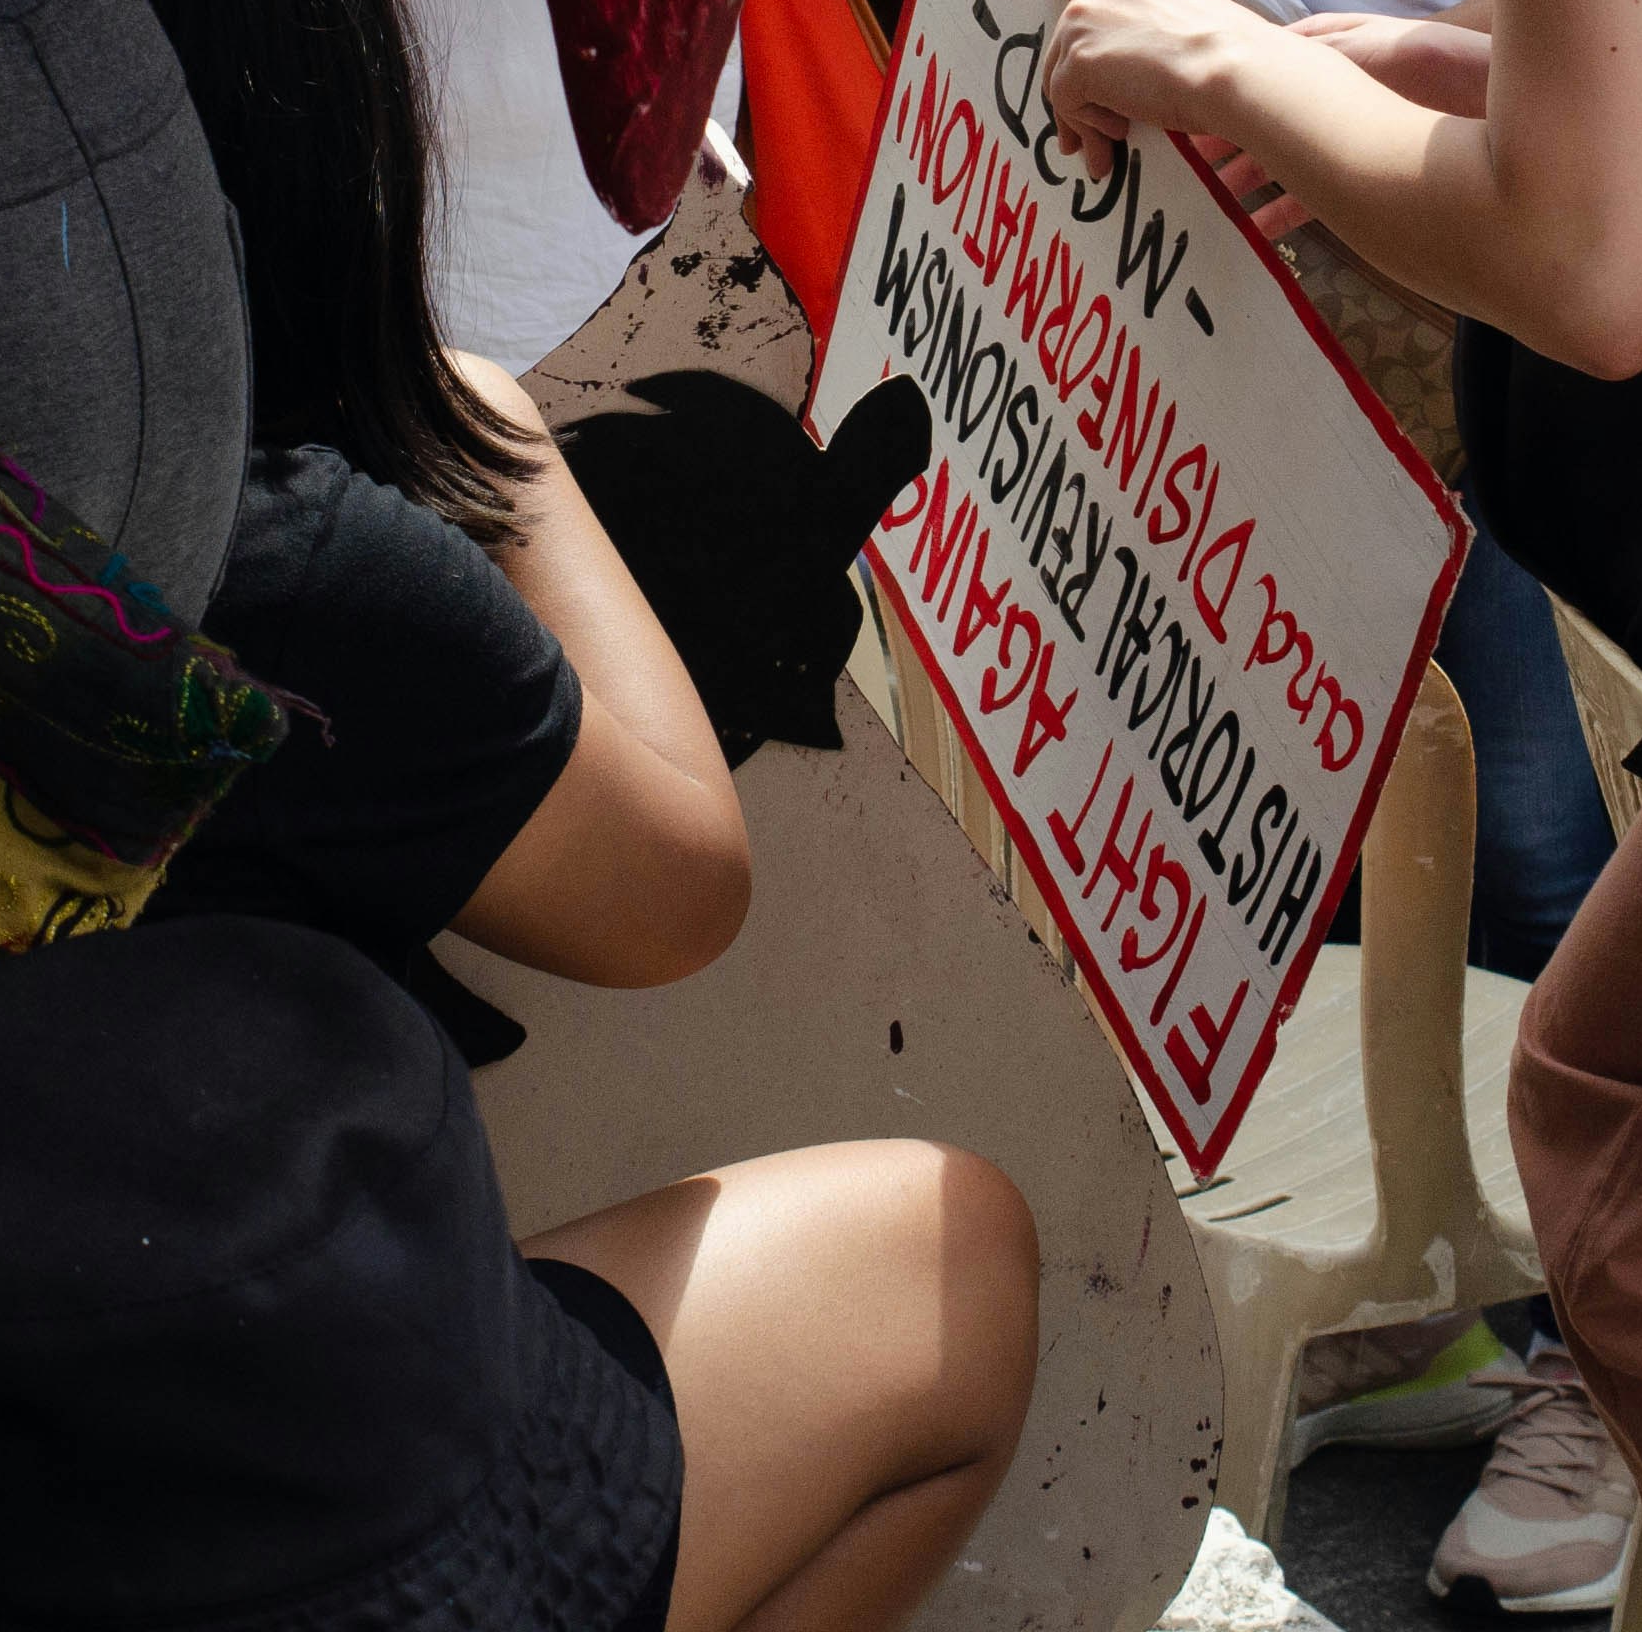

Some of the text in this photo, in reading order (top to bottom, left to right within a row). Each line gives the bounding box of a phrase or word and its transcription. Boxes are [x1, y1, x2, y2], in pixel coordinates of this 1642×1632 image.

[874, 183, 1322, 966] HISTORICAL REVISIONISM
[881, 353, 1250, 1105] FIGHT AGAIN
[896, 32, 1364, 772] and DISINFORMATION!
